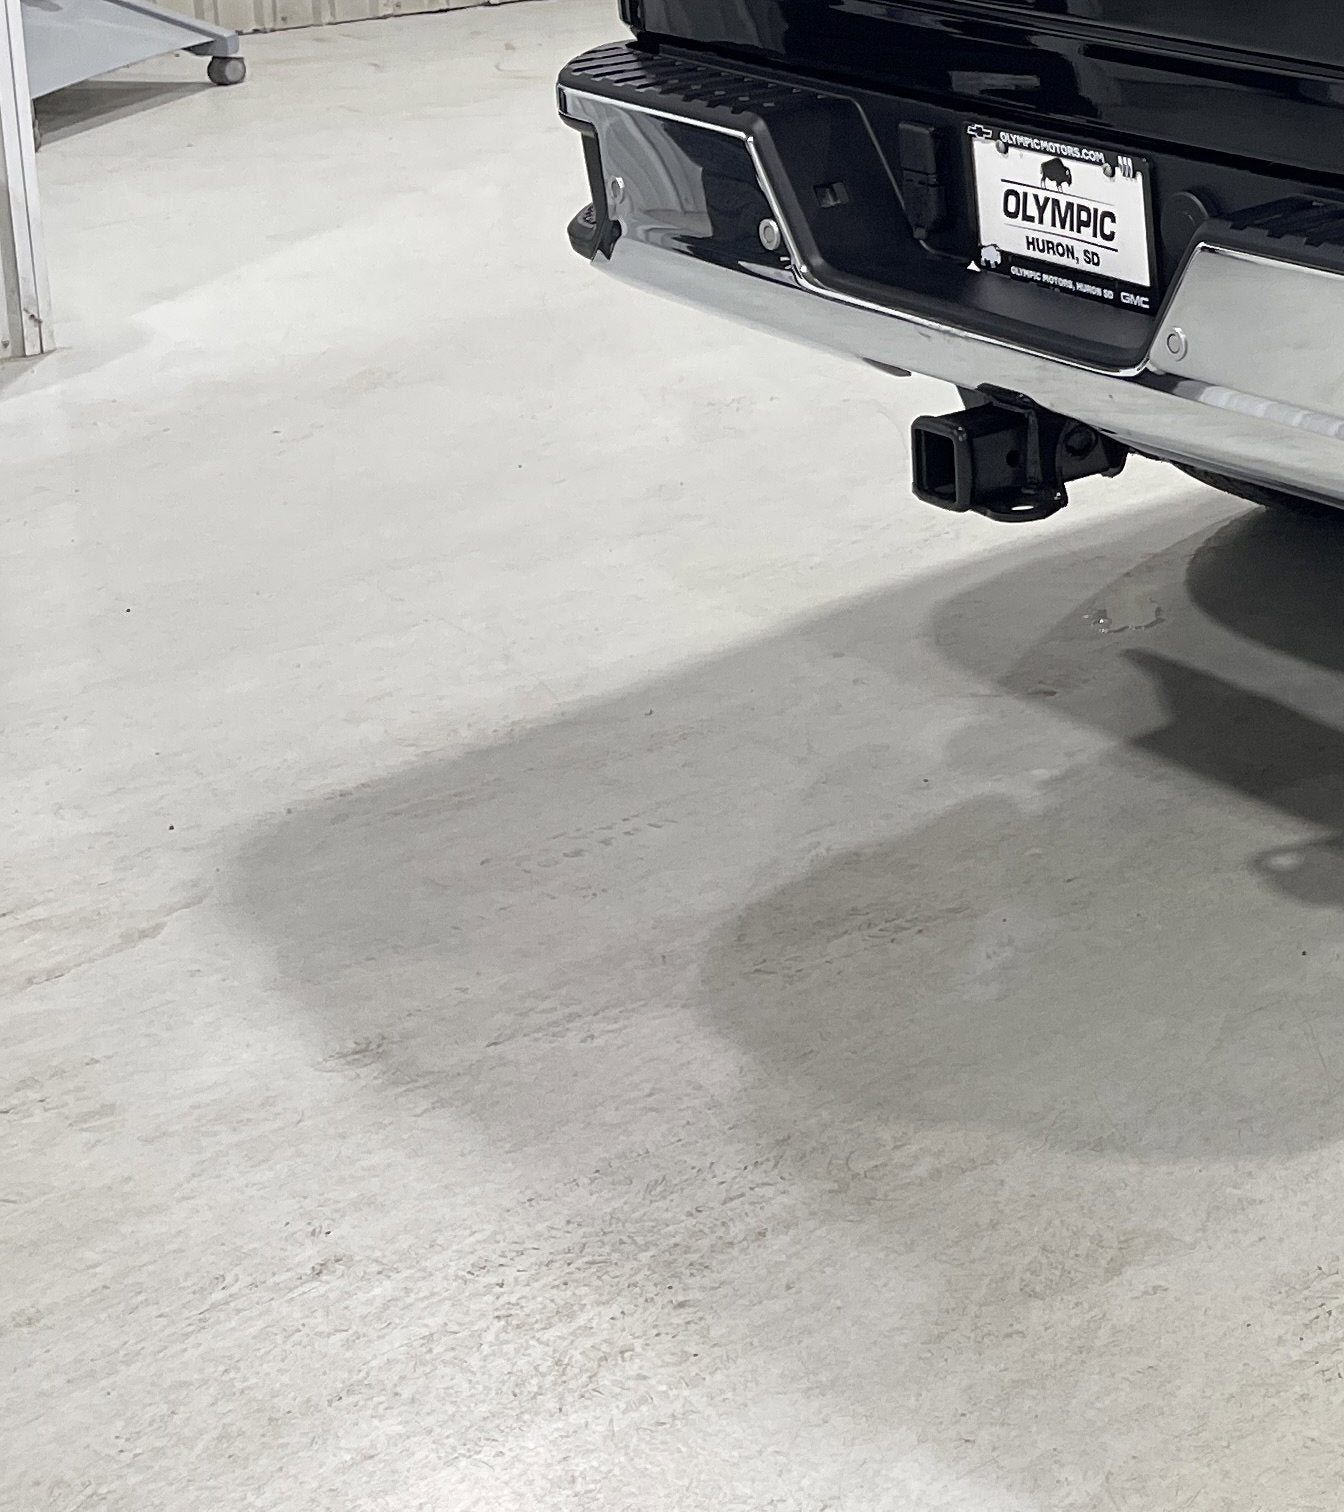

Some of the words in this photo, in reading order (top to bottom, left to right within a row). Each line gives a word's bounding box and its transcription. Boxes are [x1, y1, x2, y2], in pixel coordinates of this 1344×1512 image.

[1000, 131, 1105, 163] OLYMPICMOTORS.COM
[1003, 188, 1116, 242] OLYMPIC
[1025, 235, 1080, 264] HURON,
[1083, 249, 1100, 267] SD
[1010, 266, 1041, 281] OLYMPIC
[1120, 292, 1150, 308] GMC
